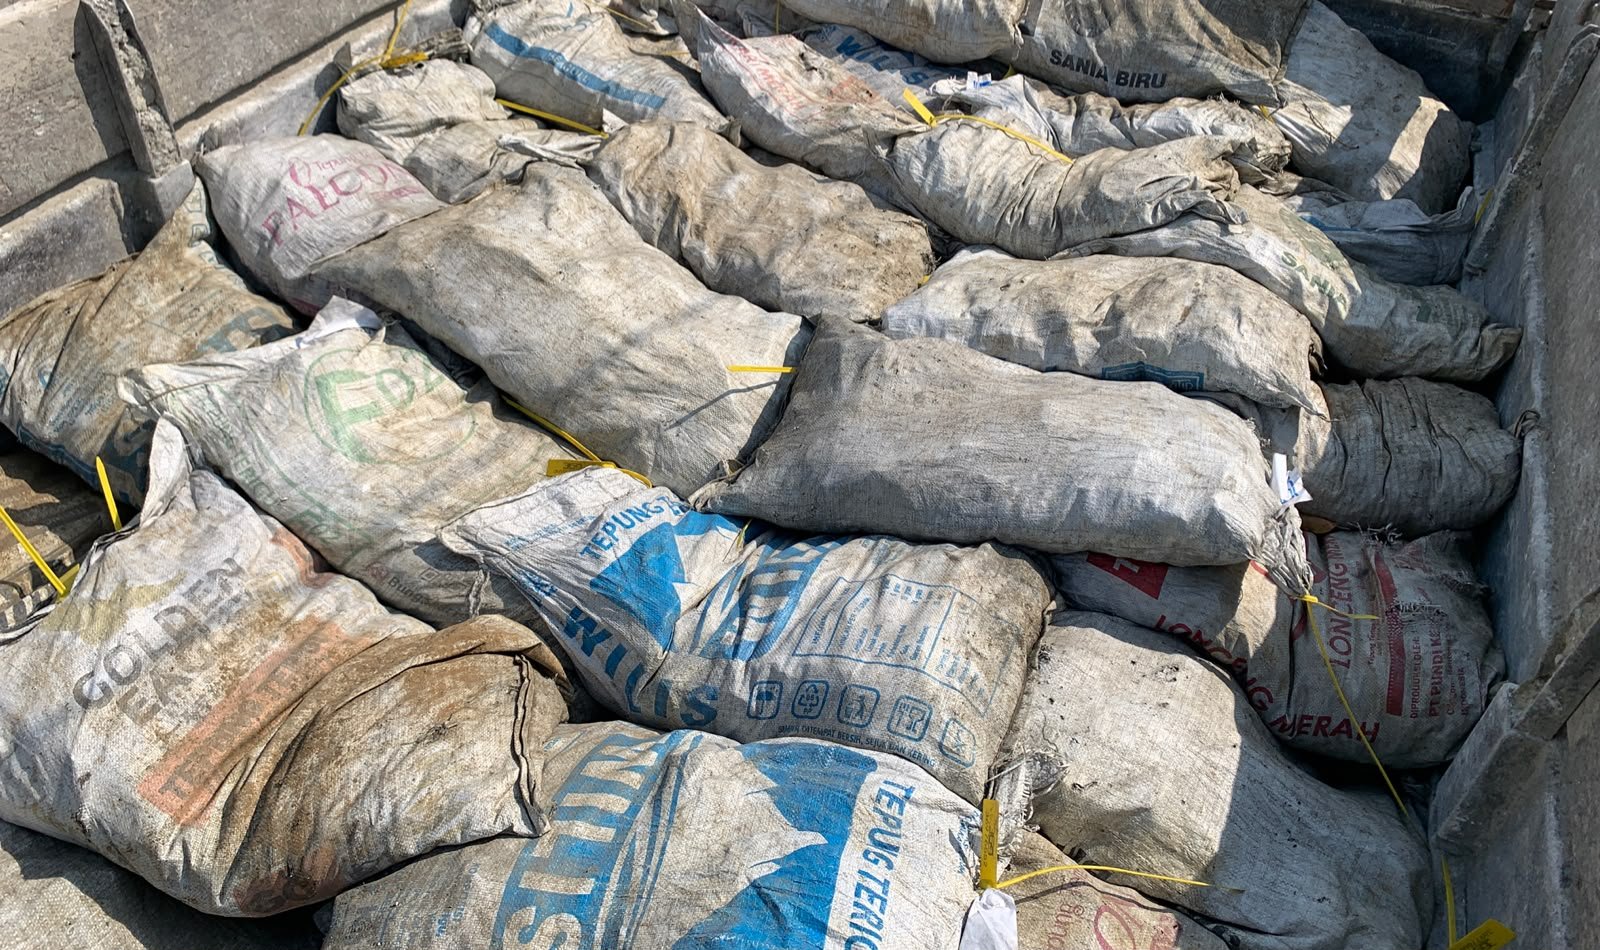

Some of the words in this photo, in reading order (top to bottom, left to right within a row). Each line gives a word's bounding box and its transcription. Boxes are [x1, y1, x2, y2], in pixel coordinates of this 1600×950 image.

[1050, 50, 1108, 82] SANIA
[1115, 70, 1168, 89] BIRU
[1281, 252, 1347, 307] SANIA
[578, 496, 665, 560] TEPUNG
[73, 557, 246, 710] GOLDEN
[563, 606, 719, 728] WILIS
[1428, 697, 1441, 717] PT
